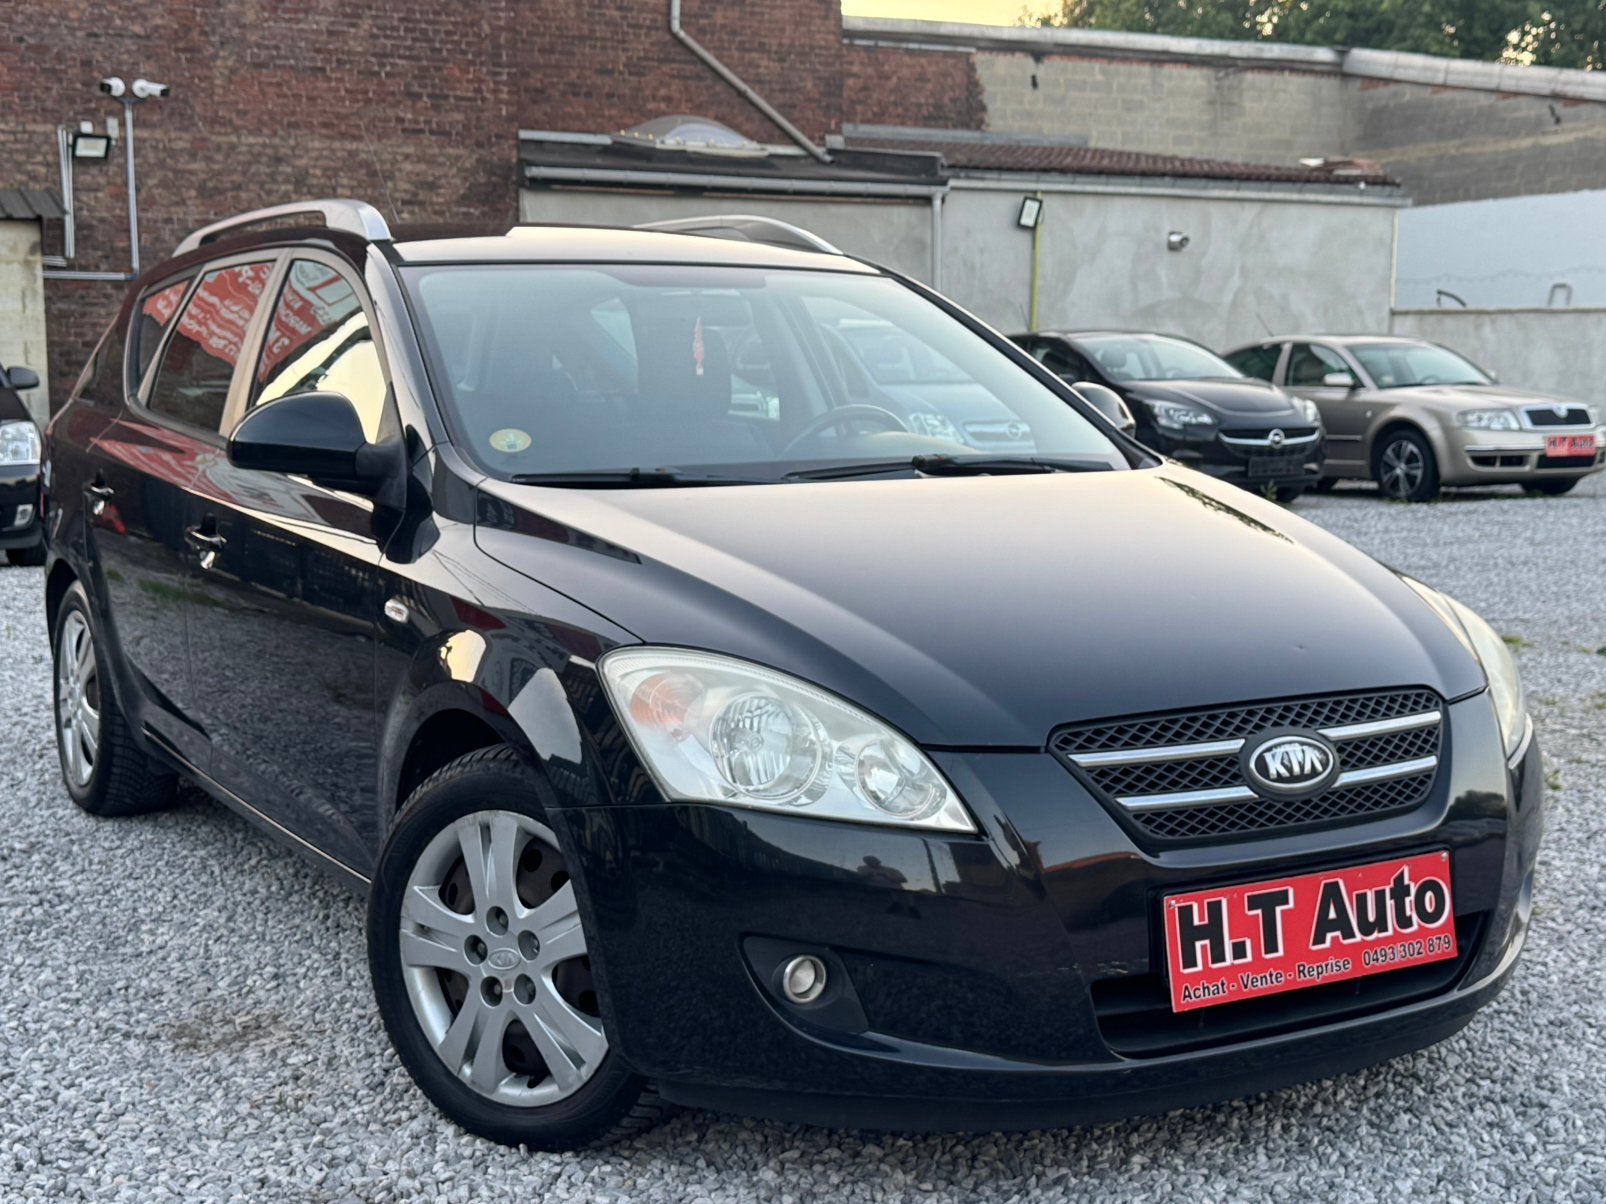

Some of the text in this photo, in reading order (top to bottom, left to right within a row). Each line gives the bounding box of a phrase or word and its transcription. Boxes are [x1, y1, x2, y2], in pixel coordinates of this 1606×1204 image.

[1263, 743, 1323, 779] KIA
[1176, 864, 1450, 973] H.T Auto
[1181, 978, 1227, 1003] Achat
[1240, 968, 1284, 991] Vente
[1296, 957, 1351, 980] Reprise
[1427, 933, 1452, 953] 879
